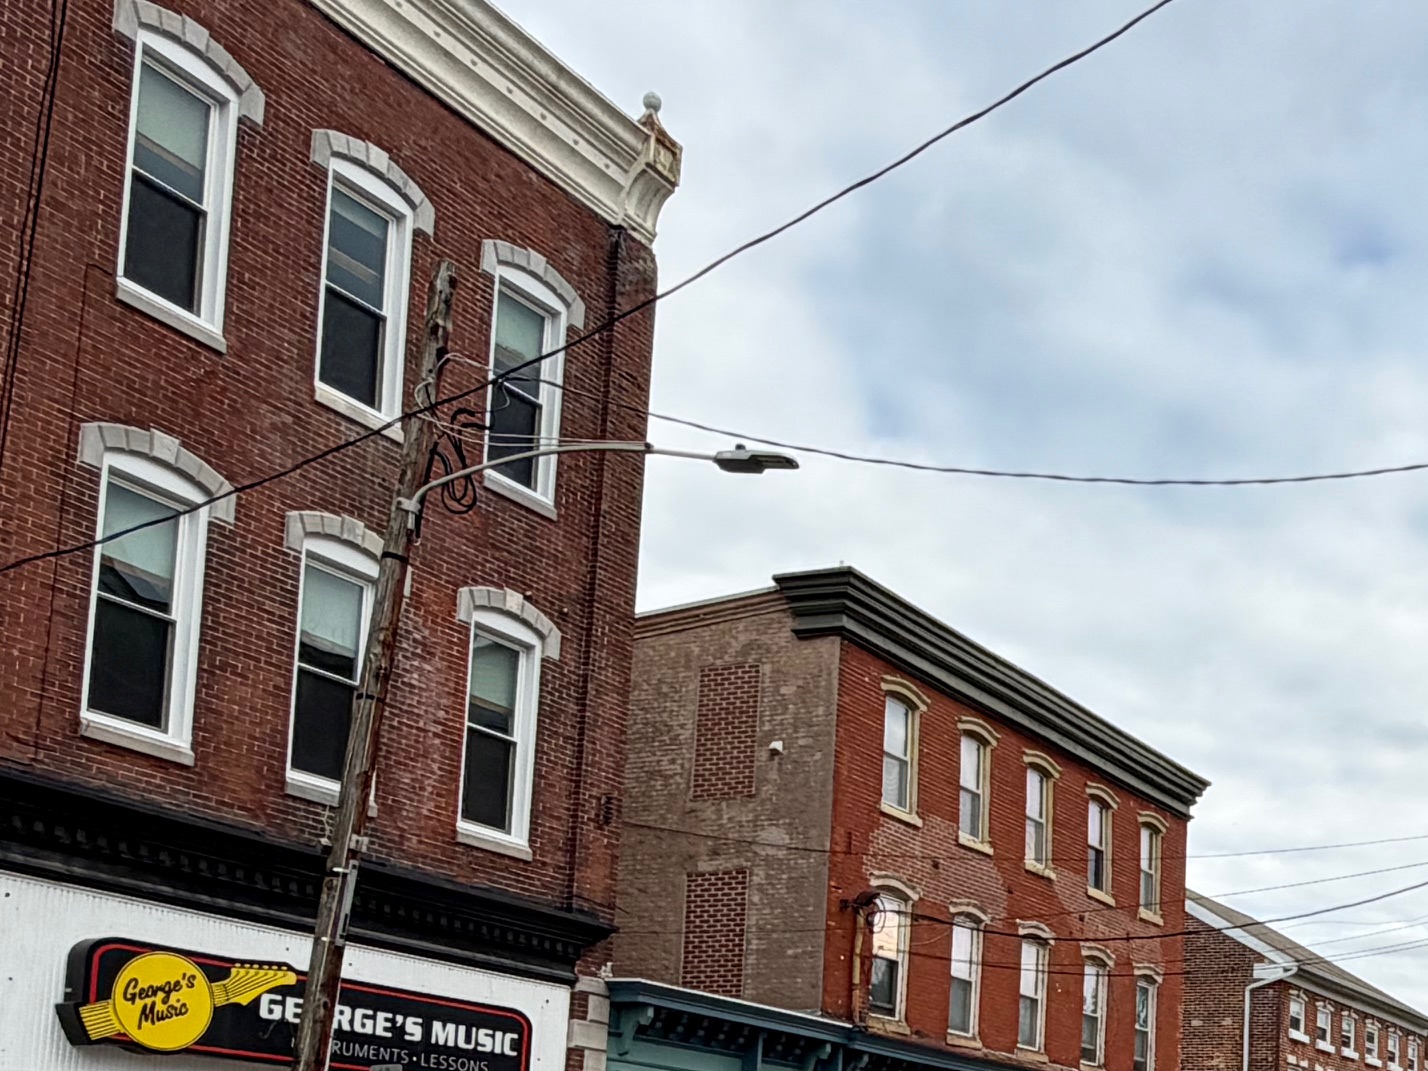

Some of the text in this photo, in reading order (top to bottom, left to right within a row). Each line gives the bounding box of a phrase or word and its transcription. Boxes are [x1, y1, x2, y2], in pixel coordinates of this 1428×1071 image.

[122, 972, 197, 1005] George's
[137, 998, 189, 1030] Music
[258, 993, 519, 1057] GERGE'S MUSIC
